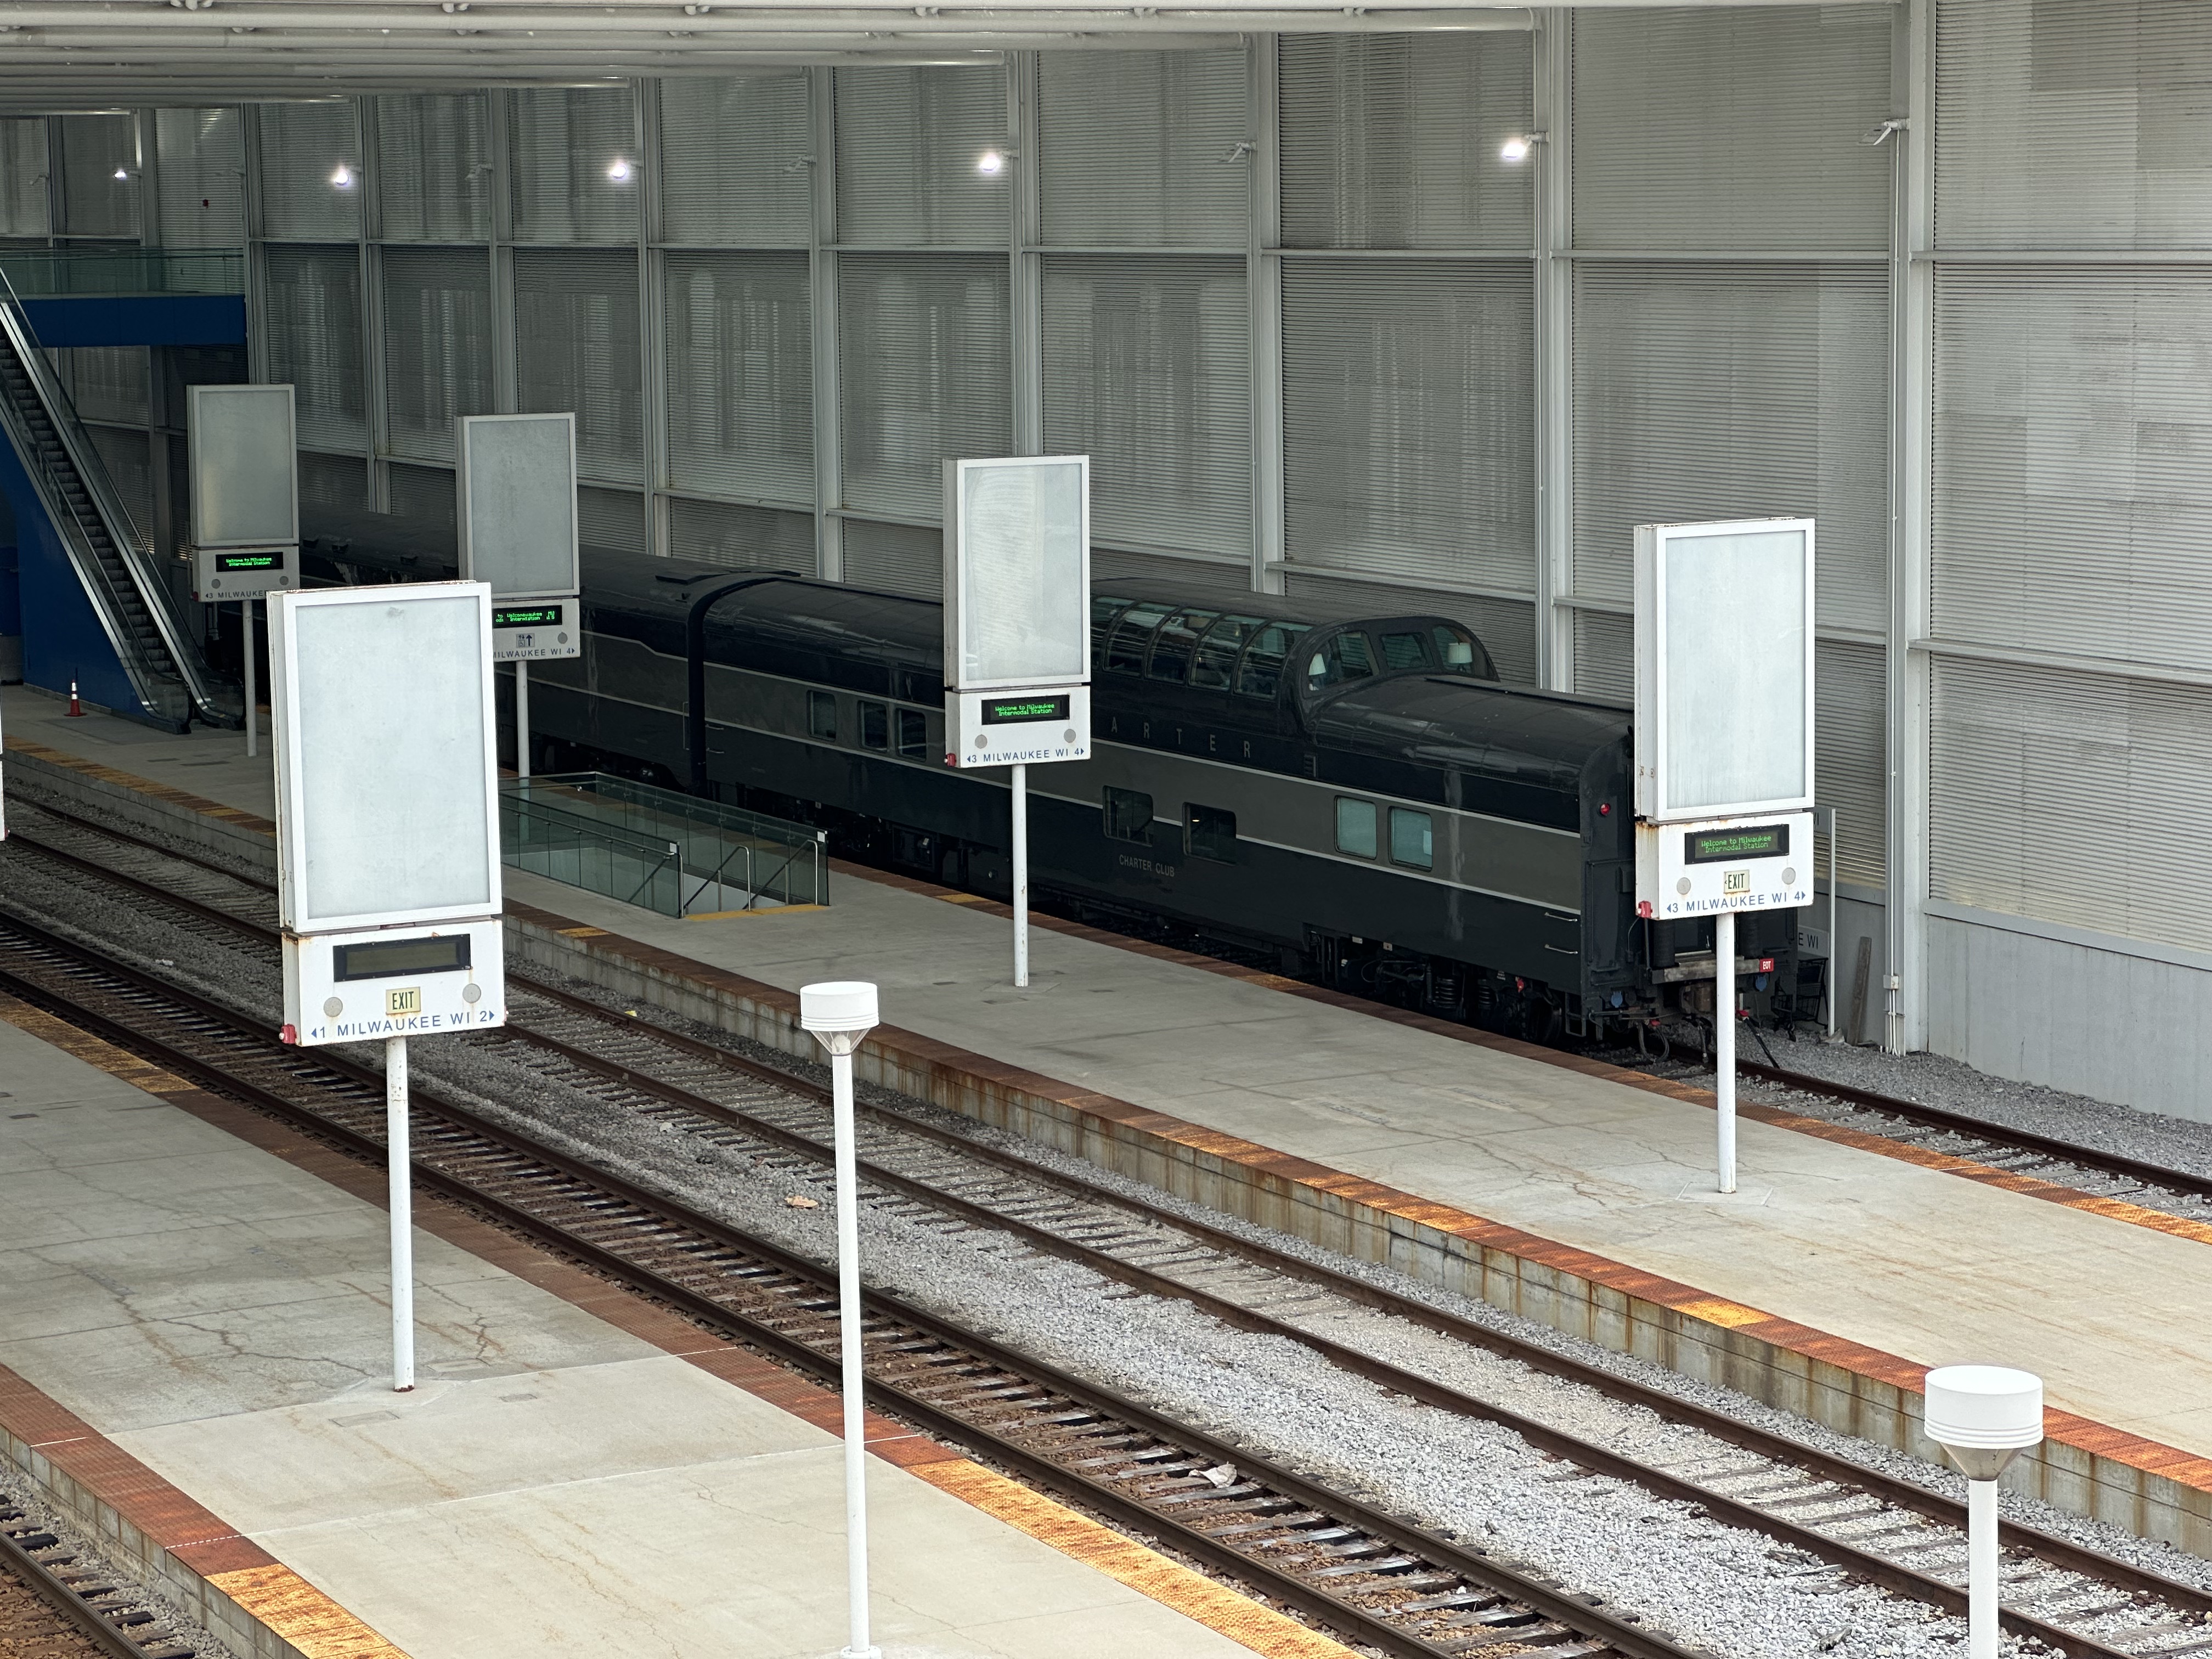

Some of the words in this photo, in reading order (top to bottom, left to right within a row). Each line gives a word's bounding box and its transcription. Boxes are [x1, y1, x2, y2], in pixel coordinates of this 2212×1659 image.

[1111, 716, 1251, 758] ARTER
[984, 749, 1049, 762] MILWAUKEE
[1056, 748, 1068, 757] WI
[1705, 843, 1741, 853] Intermodal
[1119, 854, 1152, 871] CHARTER
[1155, 862, 1175, 877] CLUB
[1728, 873, 1745, 889] EXIT
[1672, 903, 1678, 913] 3
[1686, 894, 1765, 911] MILWAUKEE
[1772, 892, 1787, 902] WI
[1795, 891, 1802, 901] 4
[1807, 934, 1818, 949] WI
[1763, 961, 1771, 970] EOT
[392, 991, 414, 1010] EXIT
[320, 1026, 325, 1038] 1
[337, 1015, 441, 1037] MILWAUKEE
[450, 1012, 470, 1025] WI
[479, 1011, 488, 1022] 2
